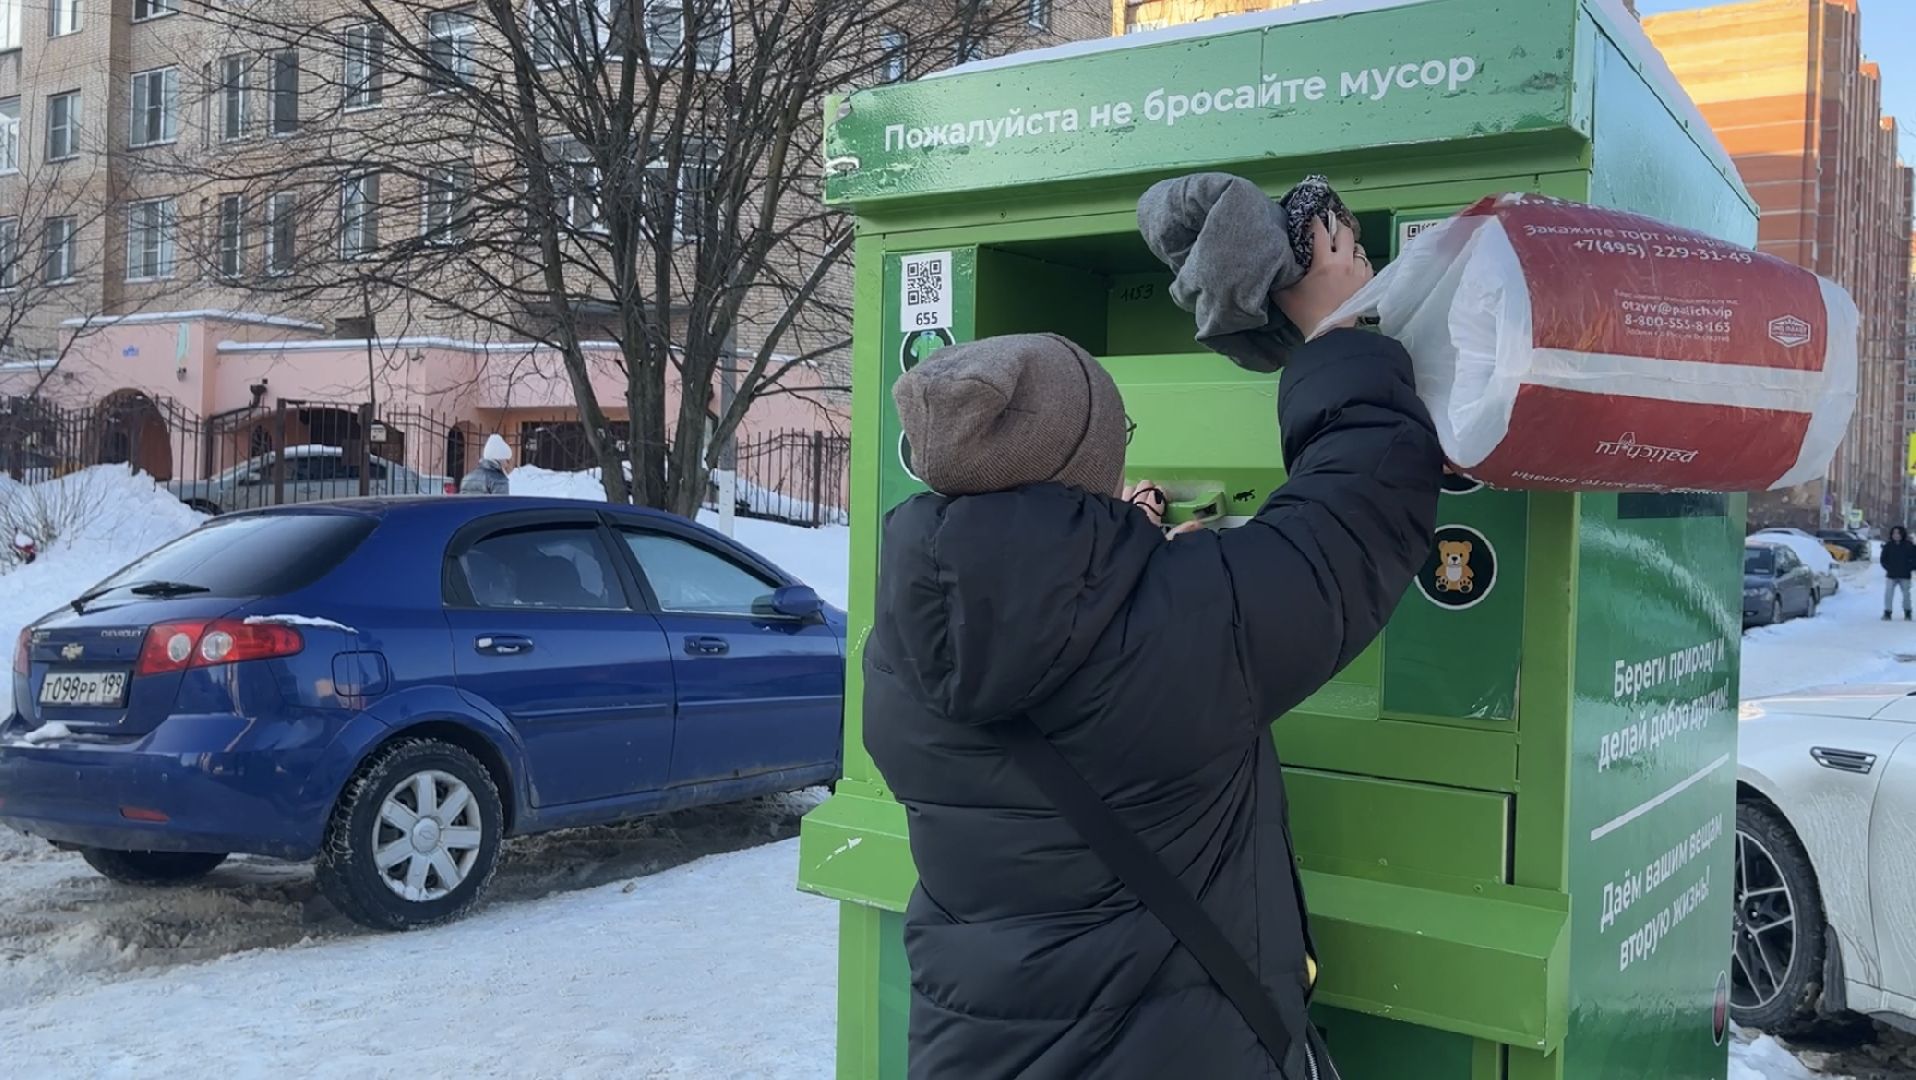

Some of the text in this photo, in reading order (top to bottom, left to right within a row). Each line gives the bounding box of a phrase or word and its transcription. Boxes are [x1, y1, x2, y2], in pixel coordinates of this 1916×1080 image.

[885, 55, 1476, 151] Пожалуйста не бросайте мусор
[1523, 224, 1615, 237] Закажите
[1620, 228, 1660, 241] торт
[1574, 239, 1752, 264] +7(495) 229-31-49
[916, 312, 938, 326] 655
[1594, 441, 1699, 463] palich.ru
[1511, 470, 1577, 484] онлайн
[1614, 636, 1725, 701] Береги природу и
[102, 674, 122, 695] 199
[1598, 677, 1729, 773] делай добро другим!
[1600, 813, 1723, 934] Даём вашим вещам
[1620, 865, 1710, 972] вторую жизнь!
